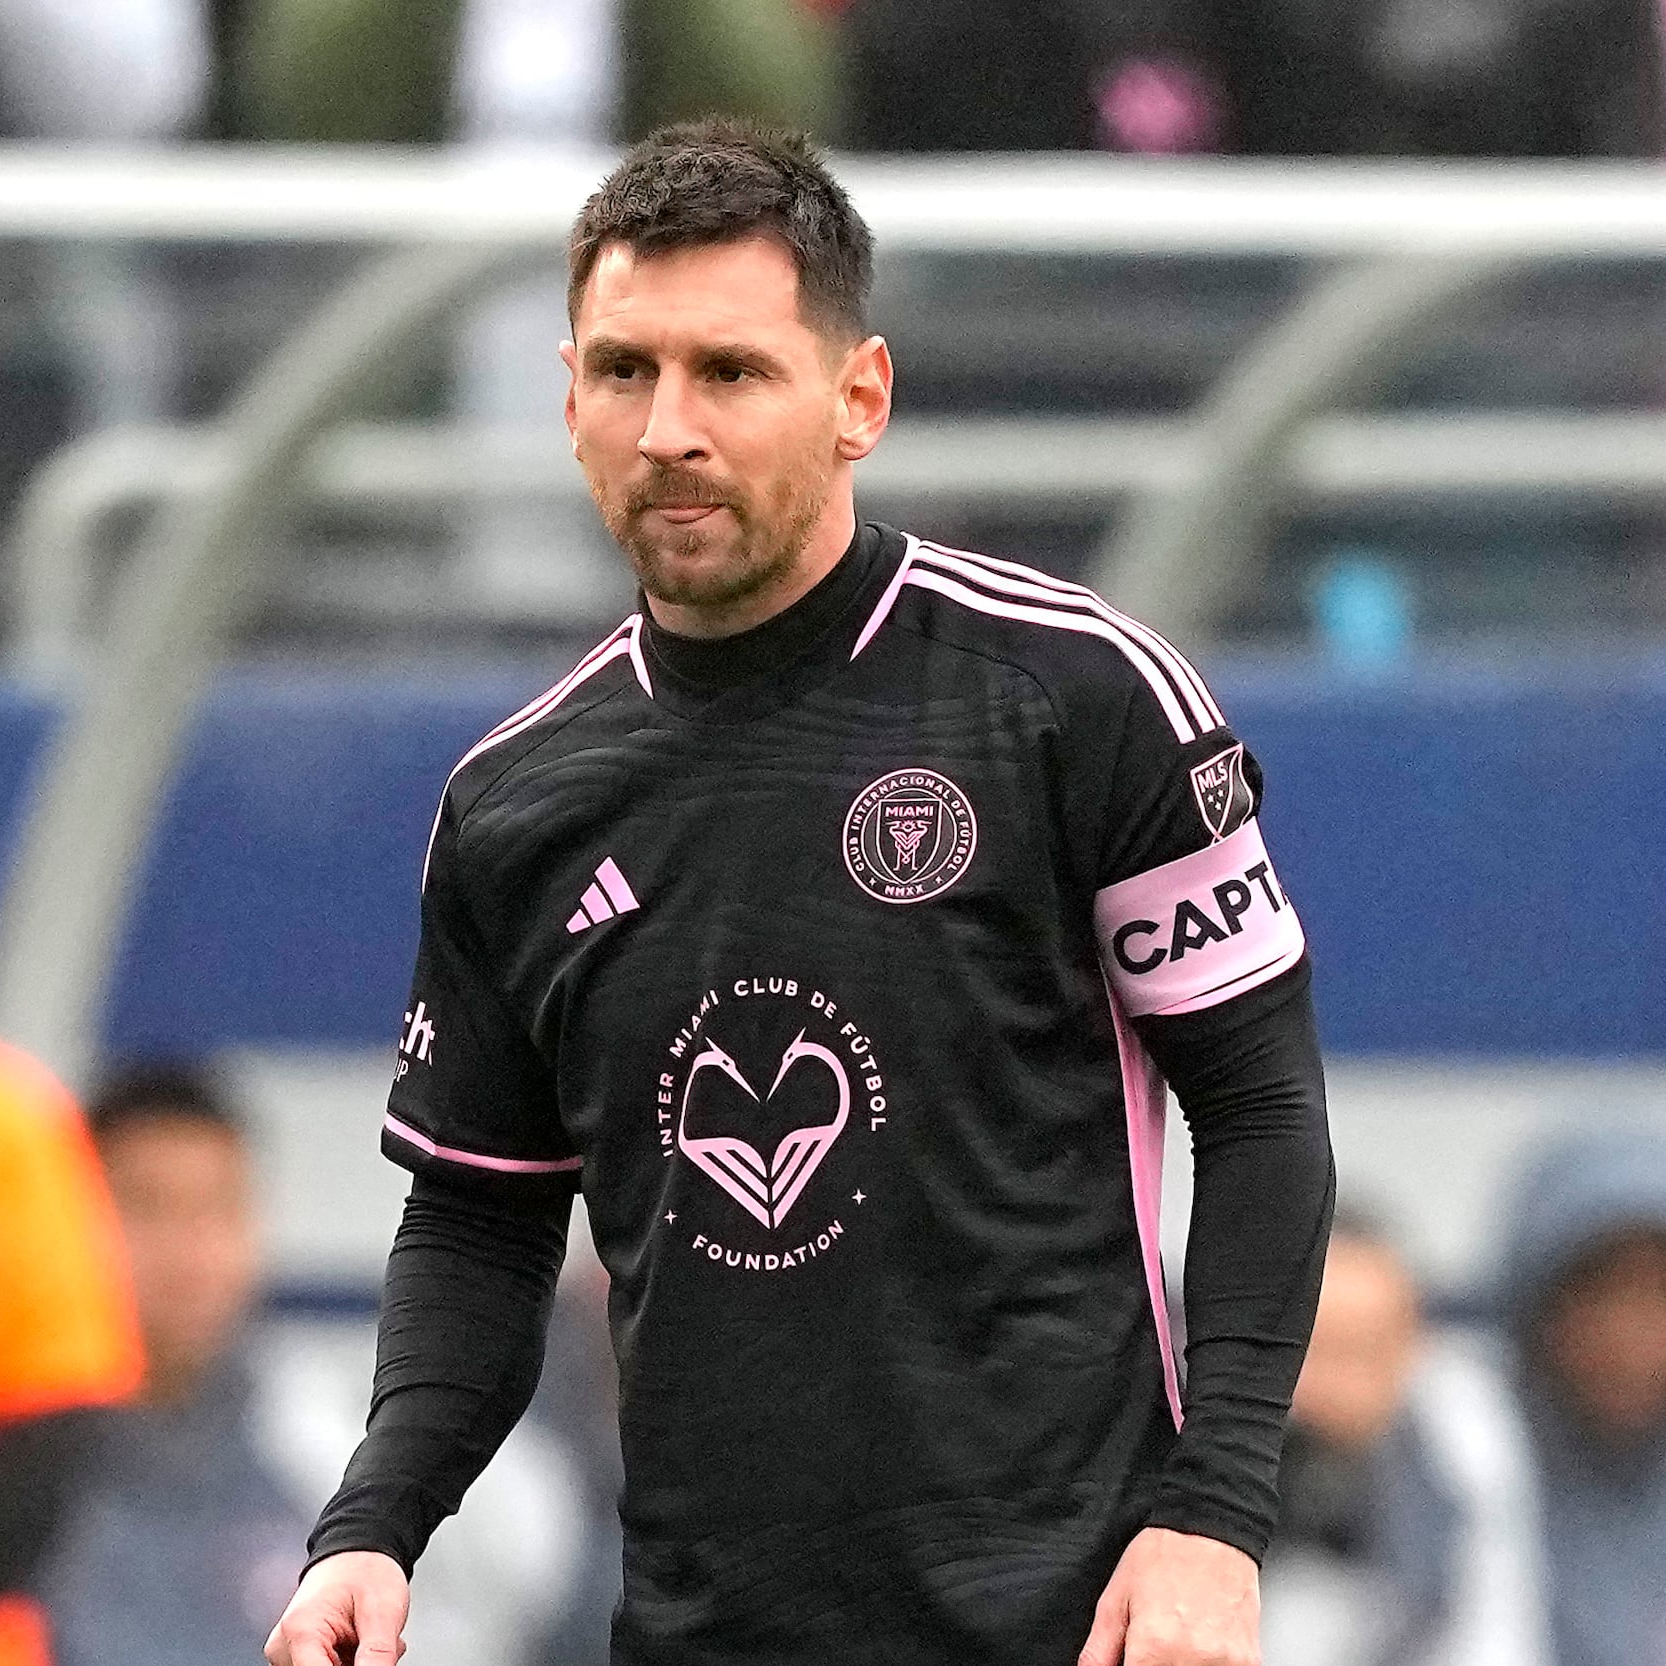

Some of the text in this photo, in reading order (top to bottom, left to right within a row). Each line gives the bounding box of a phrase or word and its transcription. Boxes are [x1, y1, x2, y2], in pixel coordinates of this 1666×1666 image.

[1197, 761, 1228, 794] MLS
[851, 776, 951, 830] INTERNACIONAL
[885, 805, 934, 817] MIAMI
[950, 799, 966, 818] DE
[849, 837, 865, 872] CLUB
[1112, 860, 1287, 975] CAPT
[658, 977, 887, 1157] INTER MIAMI CLUB DE FÚTBOL
[692, 1219, 845, 1271] FOUNDATION
